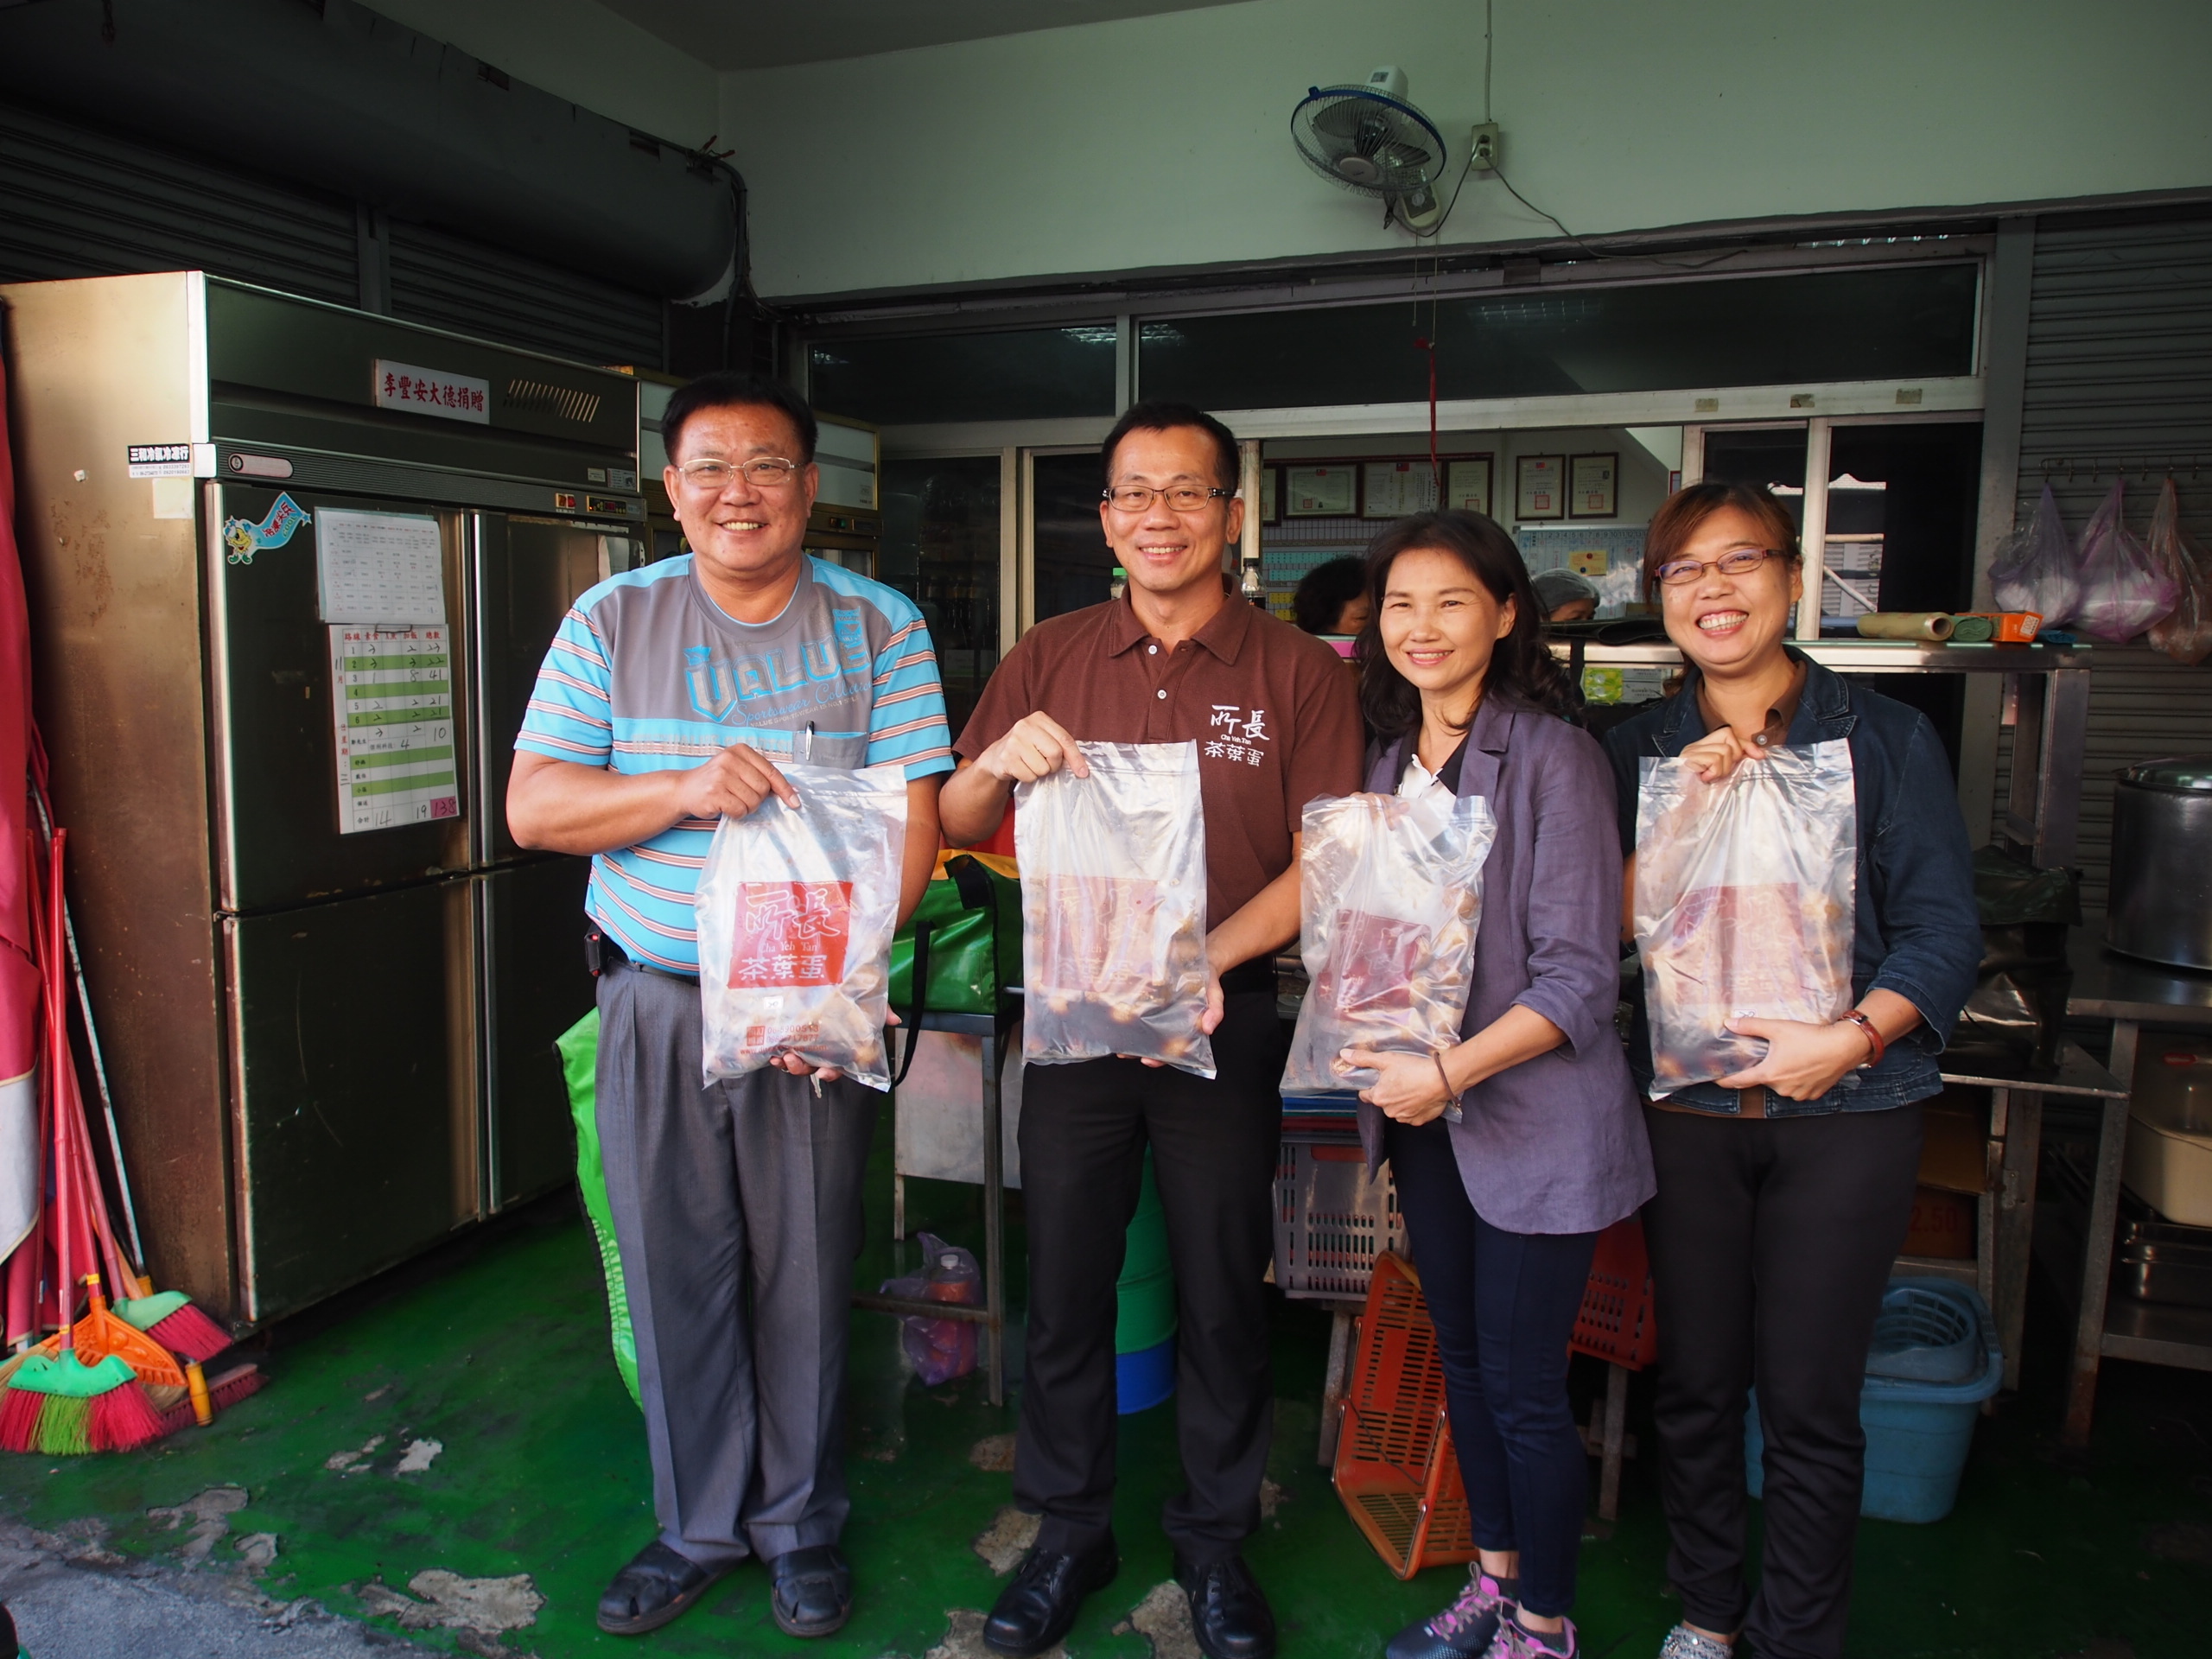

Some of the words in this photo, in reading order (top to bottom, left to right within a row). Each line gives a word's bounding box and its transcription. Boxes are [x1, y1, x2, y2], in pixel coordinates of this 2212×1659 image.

[385, 372, 484, 412] 李豐安大德捐贈
[337, 676, 343, 684] 月
[429, 669, 442, 681] 41
[684, 633, 872, 724] VALUE
[750, 719, 772, 728] VALUE
[1211, 704, 1270, 741] 所長
[434, 727, 447, 741] 10
[401, 739, 410, 750] 4
[1204, 741, 1264, 766] 茶葉蛋
[416, 804, 427, 819] 19
[434, 798, 456, 817] 138
[375, 810, 391, 827] 14
[746, 888, 842, 940] 所長
[780, 941, 796, 951] Yeh
[738, 954, 827, 981] 茶葉蛋
